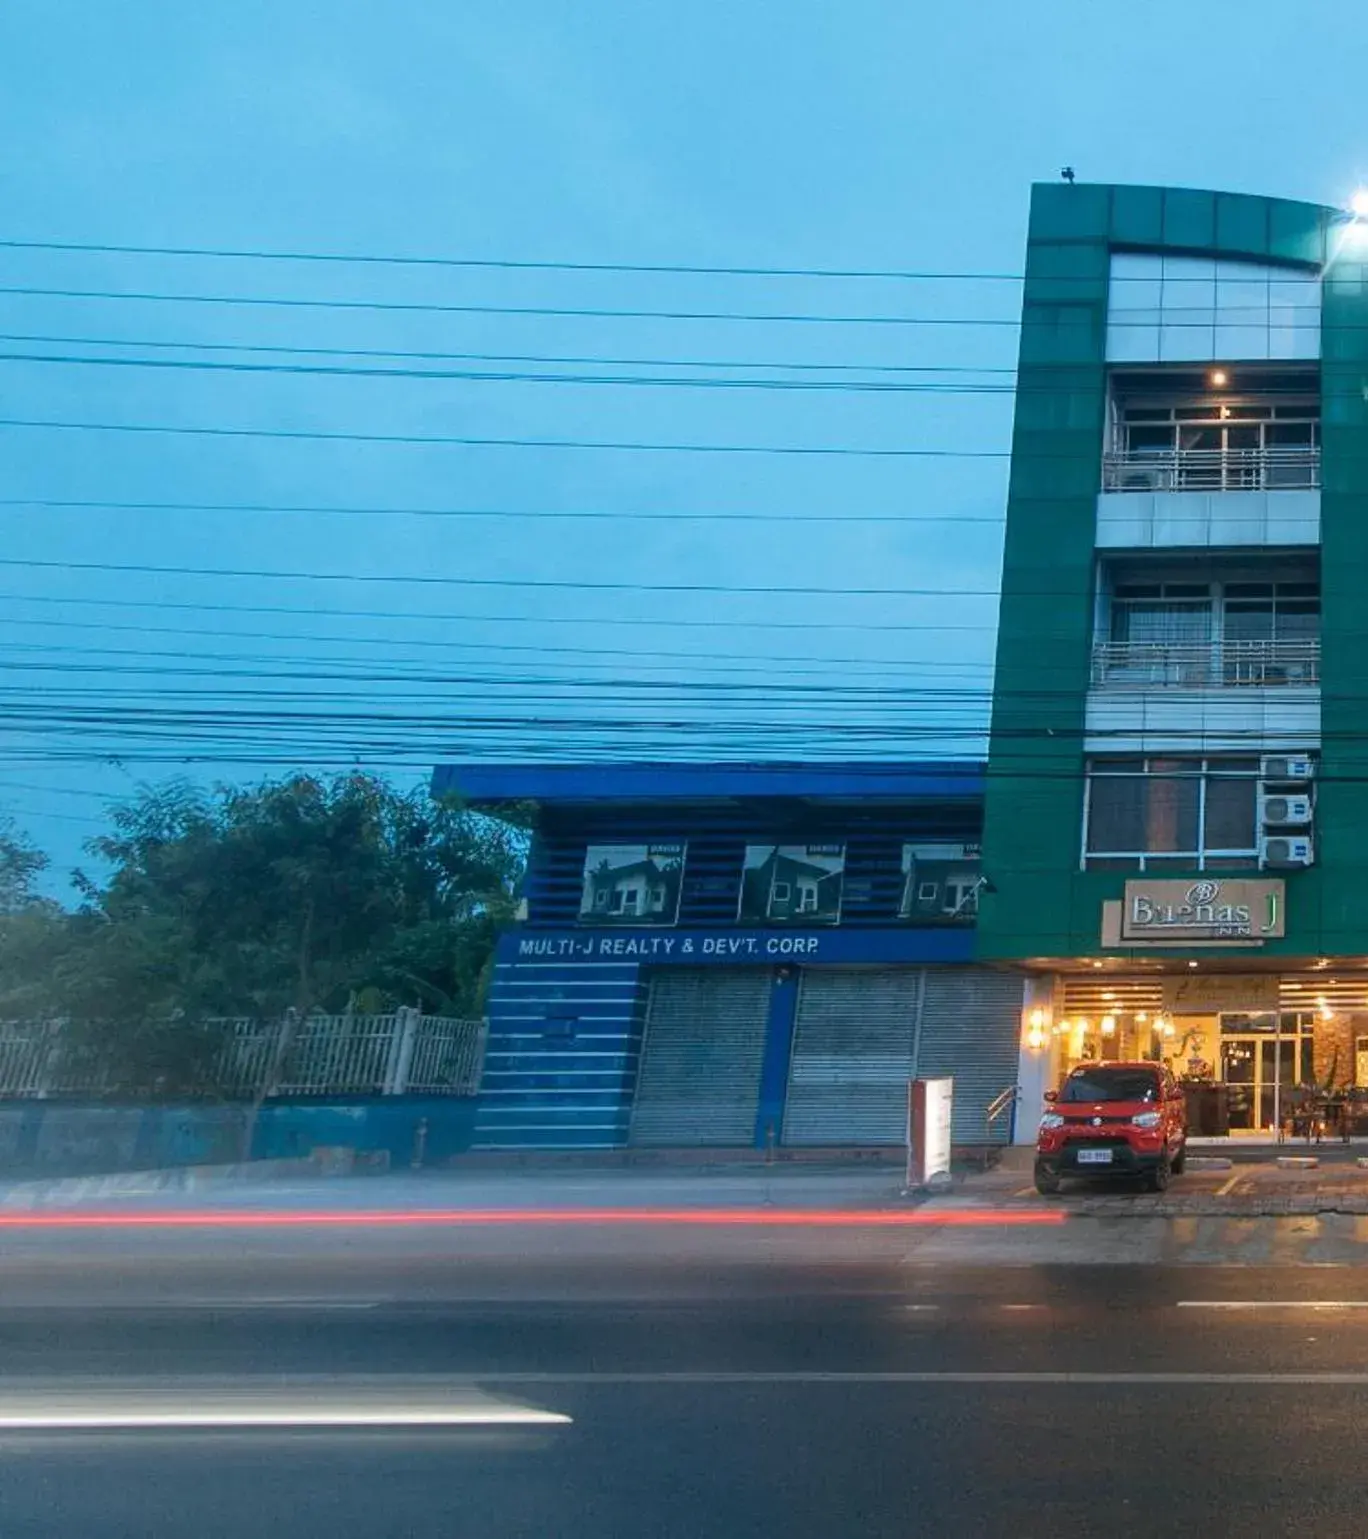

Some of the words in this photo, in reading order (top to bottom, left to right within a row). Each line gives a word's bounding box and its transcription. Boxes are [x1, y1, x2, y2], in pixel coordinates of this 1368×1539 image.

[1261, 892, 1280, 933] J
[519, 938, 593, 955] MULTI-J
[600, 938, 675, 955] REALTY
[682, 938, 694, 953] &
[767, 938, 818, 954] CORP.
